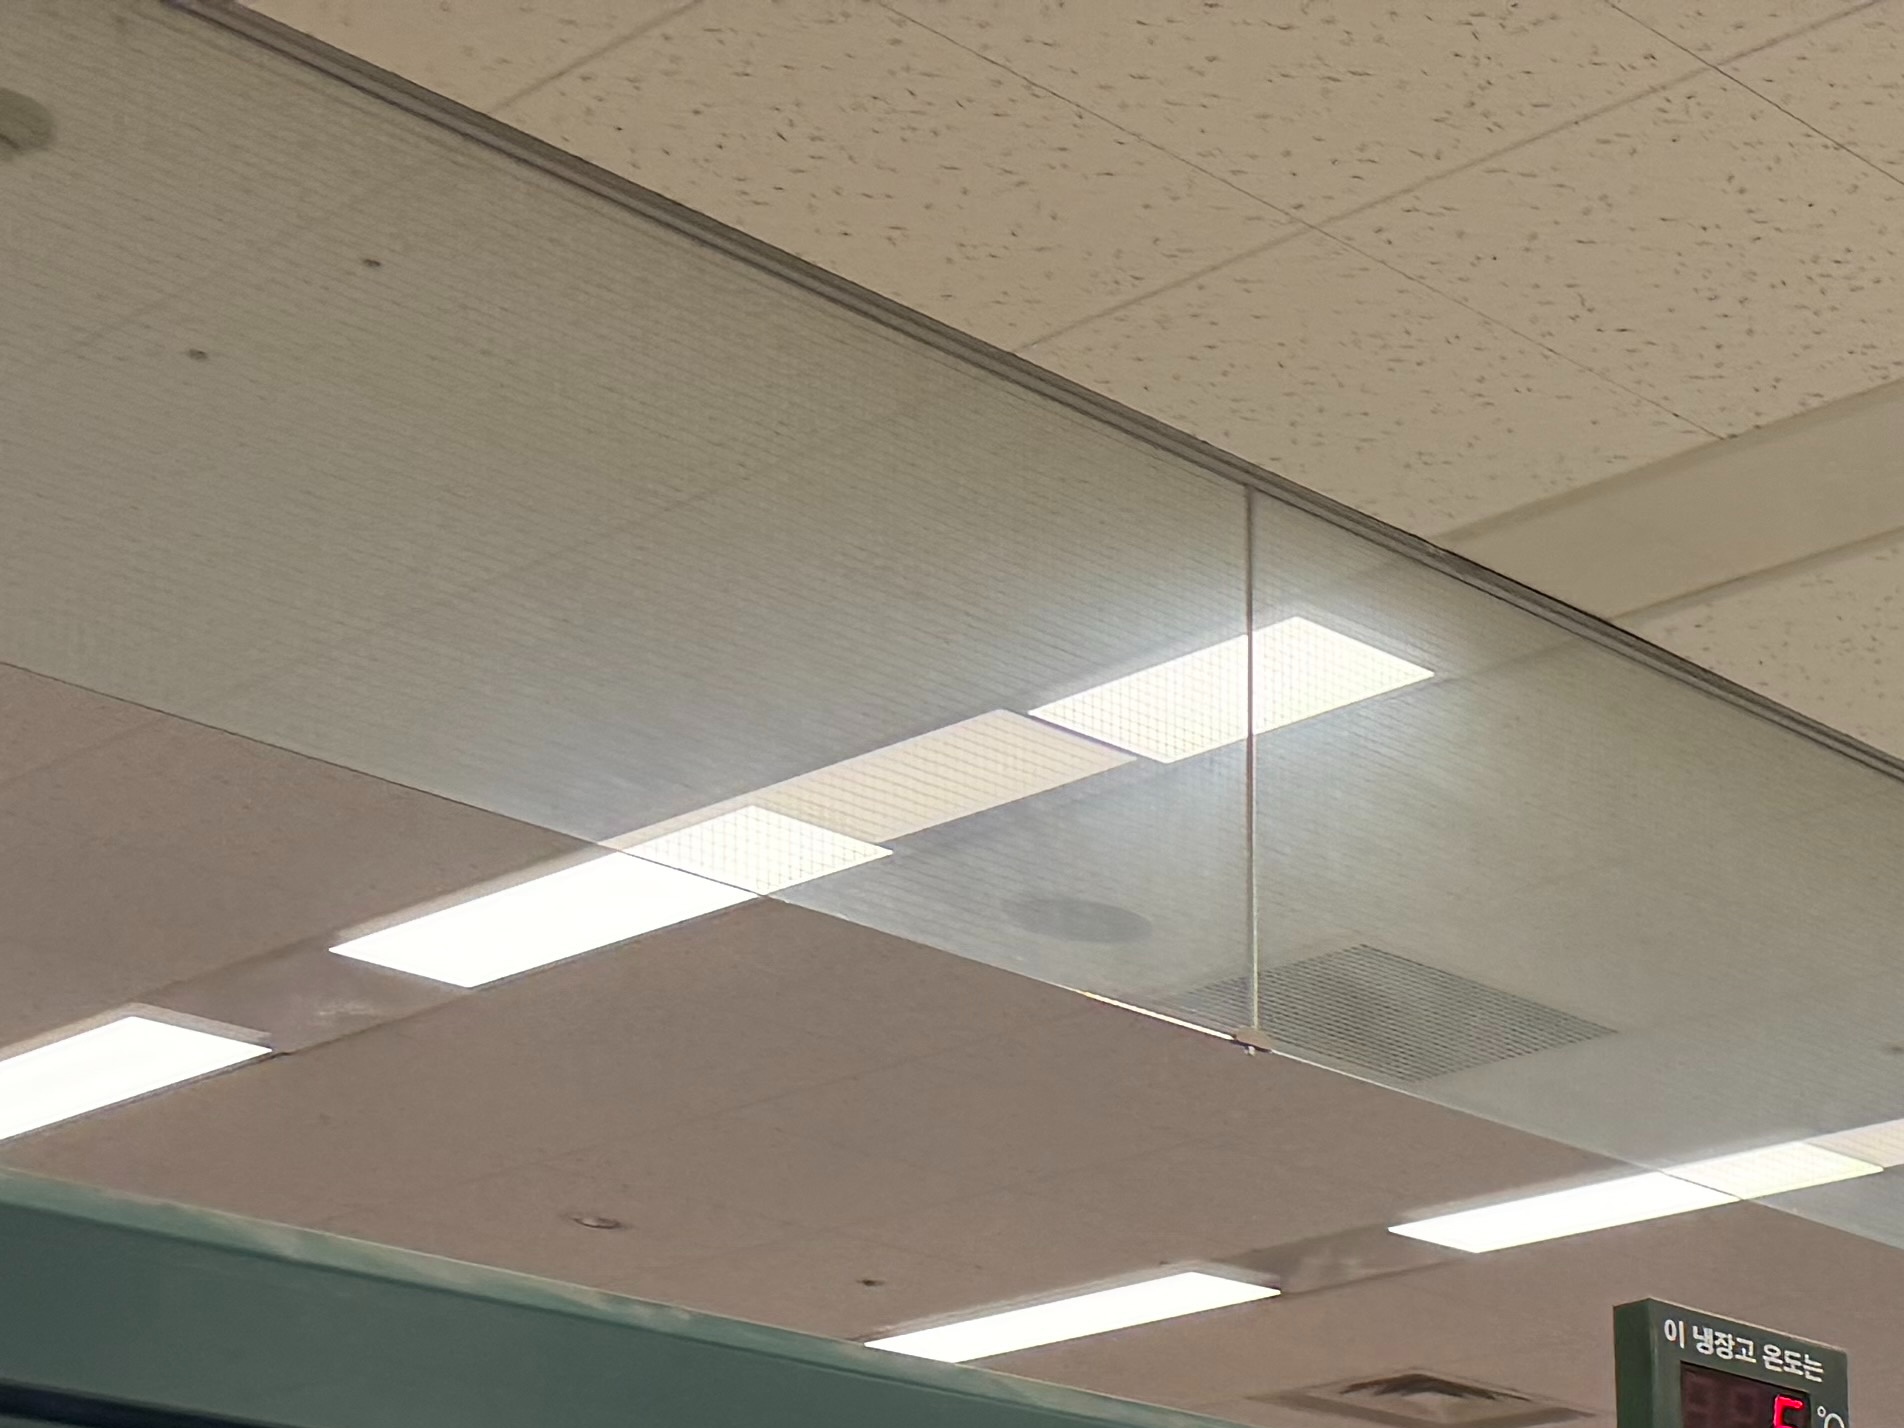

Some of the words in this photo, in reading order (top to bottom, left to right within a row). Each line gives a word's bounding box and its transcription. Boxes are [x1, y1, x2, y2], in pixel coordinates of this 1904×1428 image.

[1664, 1319, 1685, 1348] 이
[1692, 1325, 1757, 1363] 냉장고
[1762, 1345, 1824, 1382] 온도는
